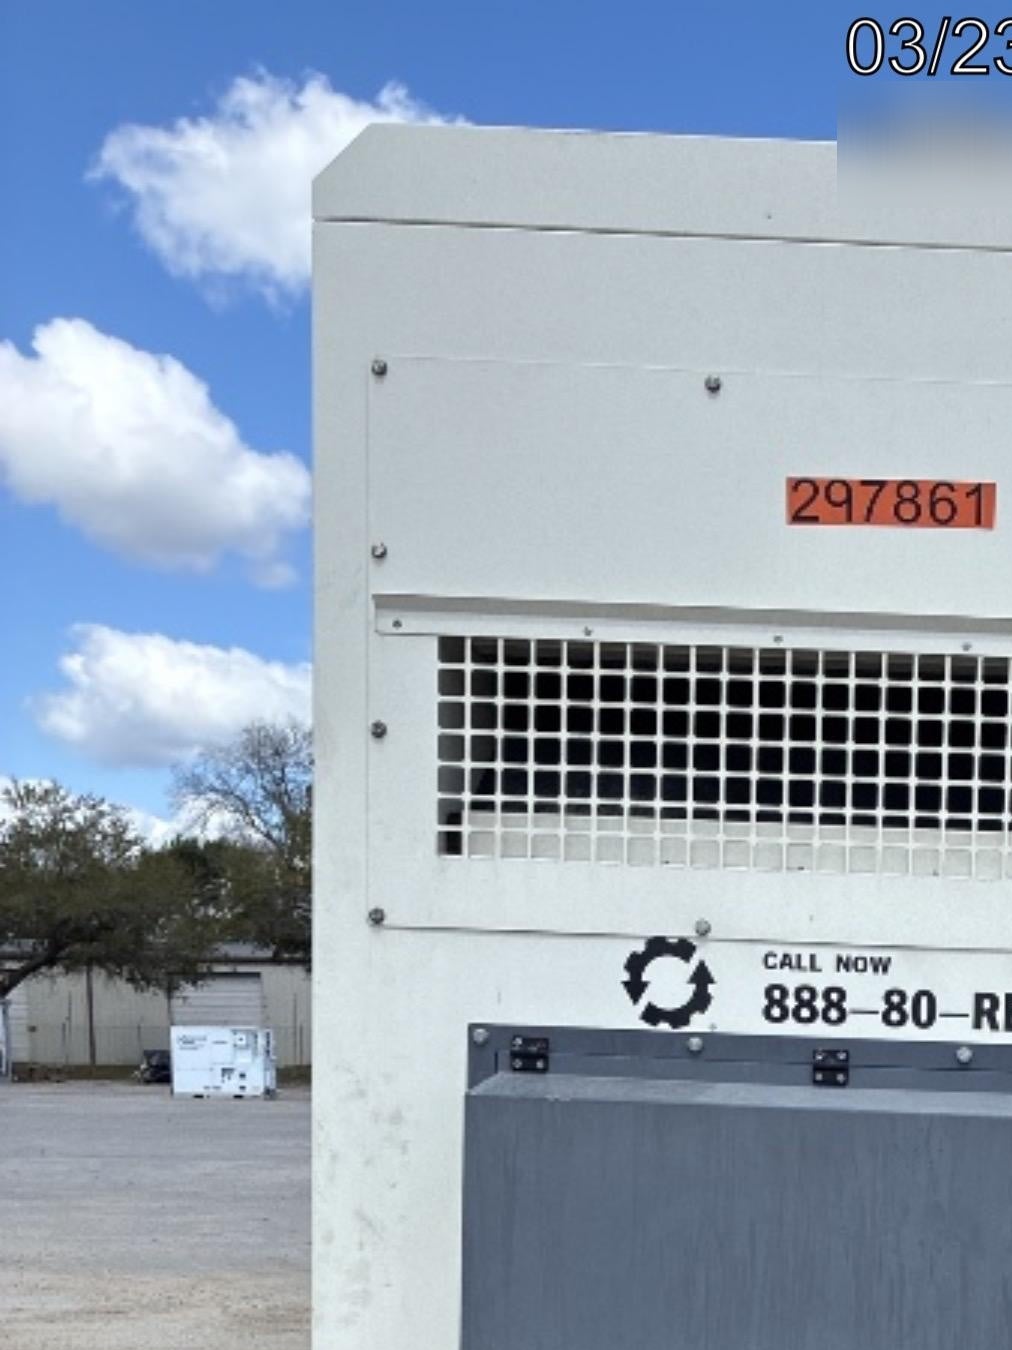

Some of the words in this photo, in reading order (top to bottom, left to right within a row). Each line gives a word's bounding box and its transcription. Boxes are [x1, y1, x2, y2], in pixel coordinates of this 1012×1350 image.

[791, 479, 983, 526] 297861
[762, 951, 823, 974] CALL
[835, 953, 893, 976] NOW
